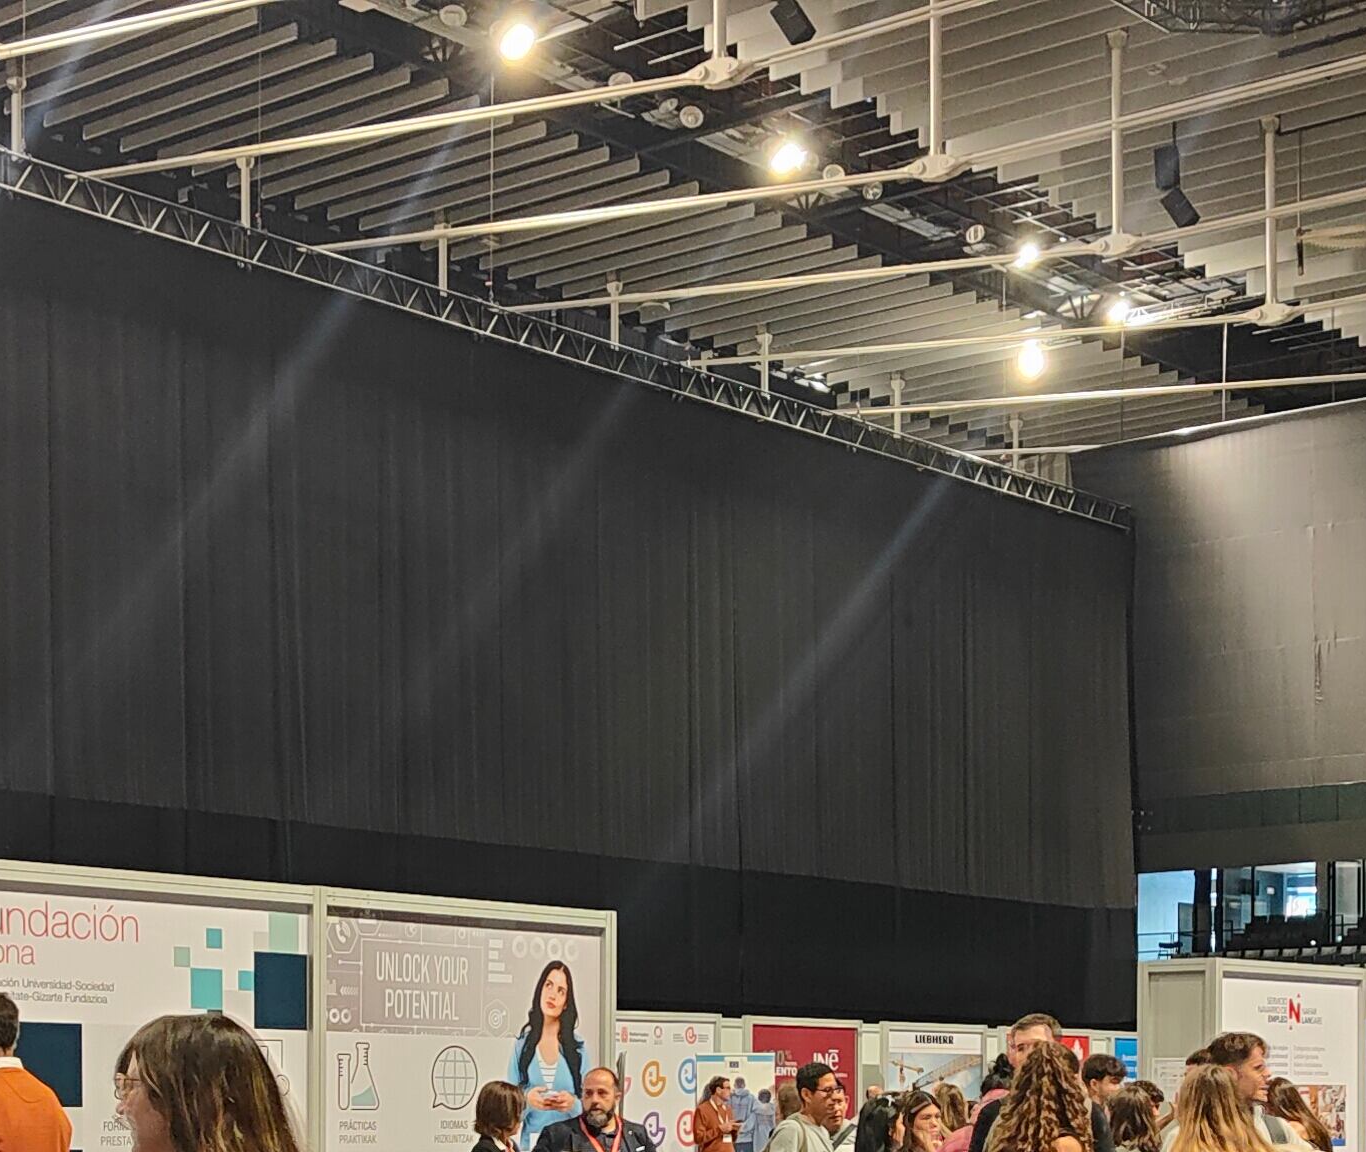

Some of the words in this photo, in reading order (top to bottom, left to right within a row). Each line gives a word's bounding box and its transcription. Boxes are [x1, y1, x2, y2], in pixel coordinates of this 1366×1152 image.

[375, 951, 429, 983] UNLOCK
[434, 955, 469, 985] YOUR
[22, 978, 115, 992] Universidad-Sociedad
[385, 988, 460, 1021] POTENTIAL
[915, 1034, 954, 1045] LIEBHERR
[440, 1120, 469, 1130] IDIOMAS
